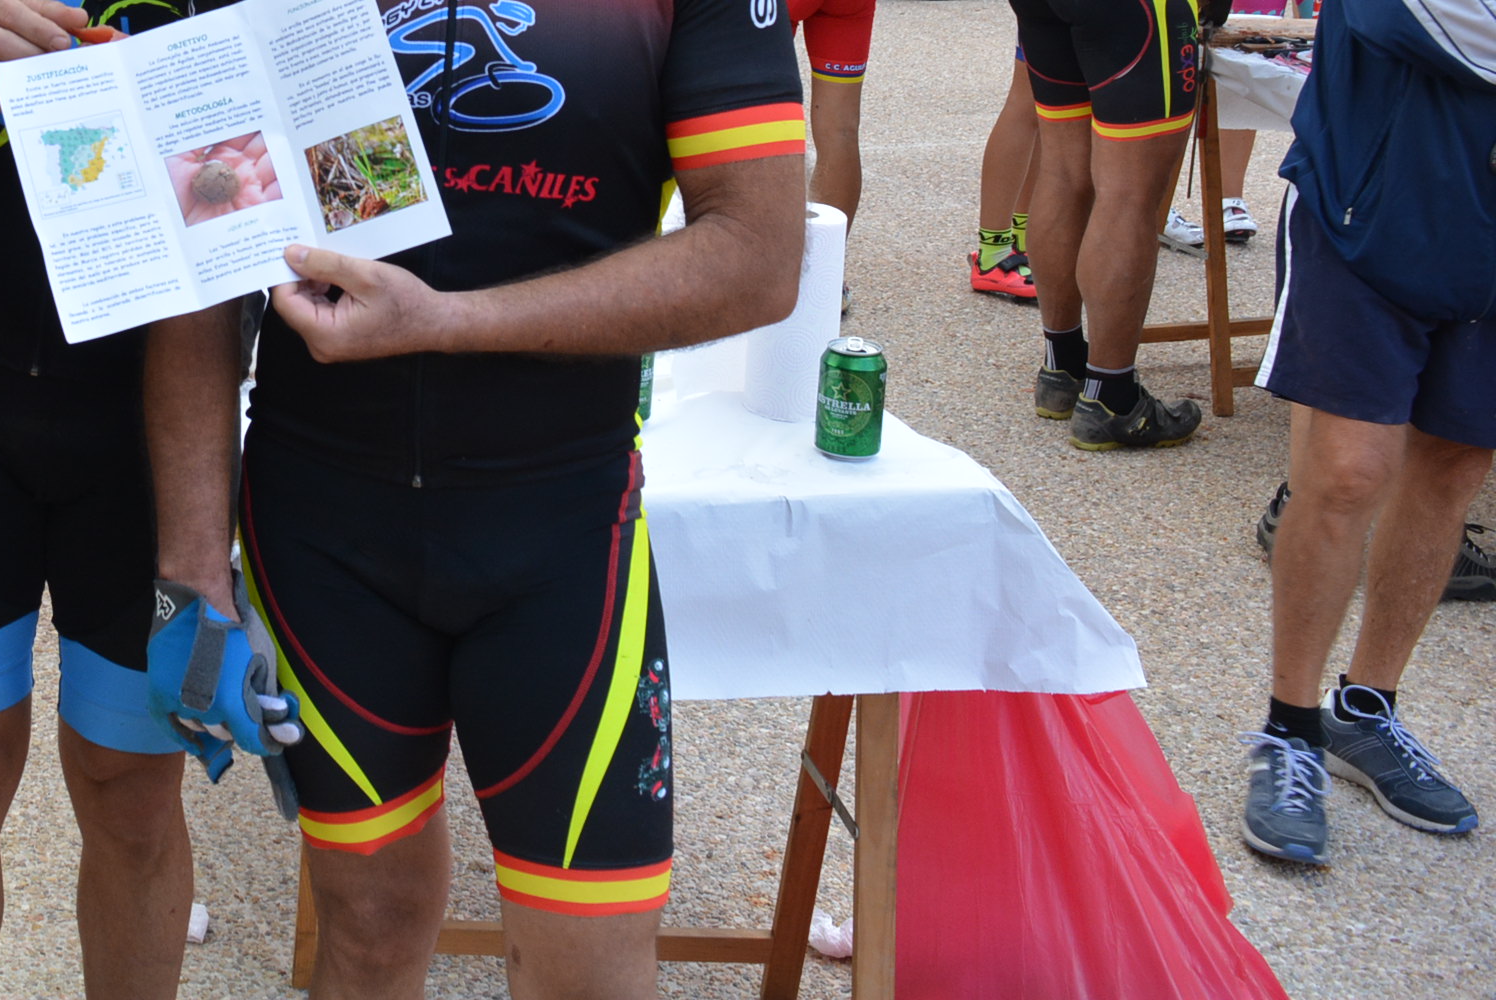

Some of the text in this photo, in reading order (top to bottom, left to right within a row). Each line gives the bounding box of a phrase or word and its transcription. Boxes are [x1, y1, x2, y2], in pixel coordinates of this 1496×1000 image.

[166, 33, 208, 52] OBJETIVO
[26, 63, 88, 82] JUSTIFICACIÓN
[174, 95, 233, 120] METODOLOGÍA
